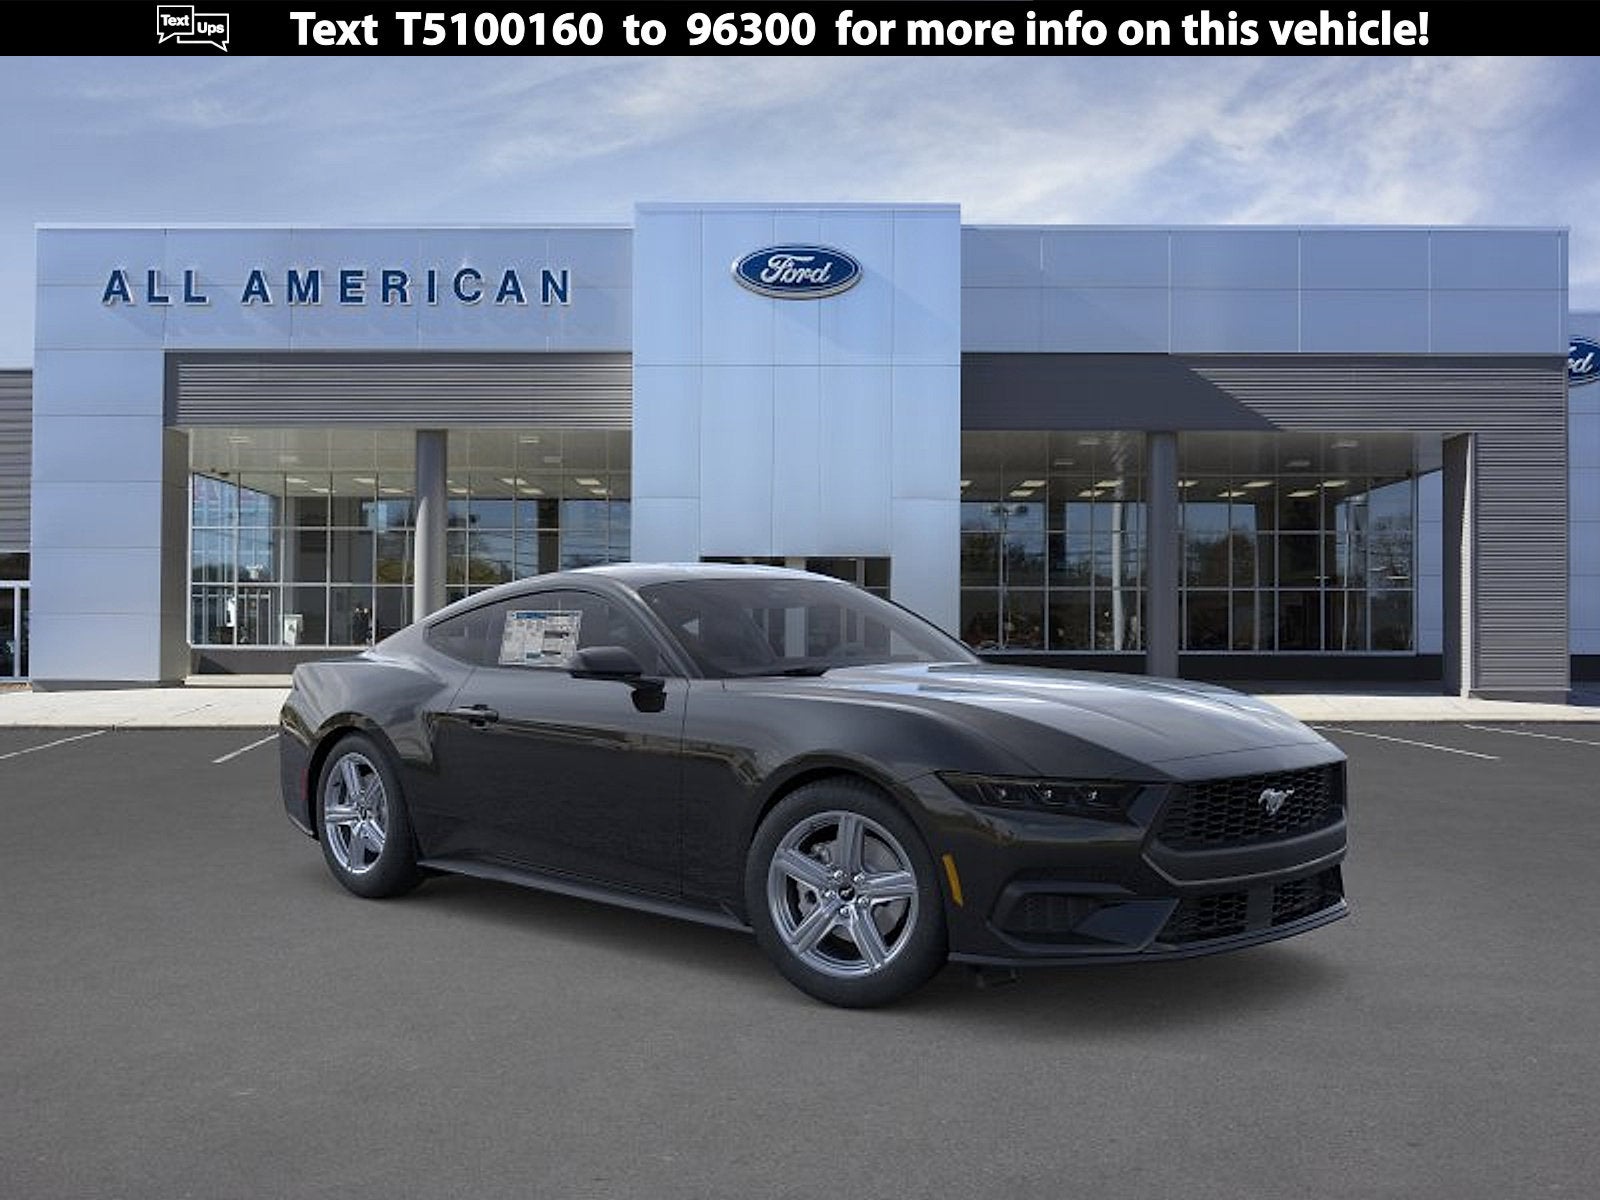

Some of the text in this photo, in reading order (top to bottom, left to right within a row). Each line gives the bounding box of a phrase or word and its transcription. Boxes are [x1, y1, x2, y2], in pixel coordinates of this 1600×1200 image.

[760, 254, 833, 284] Ford
[103, 267, 571, 306] ALL AMERICAN
